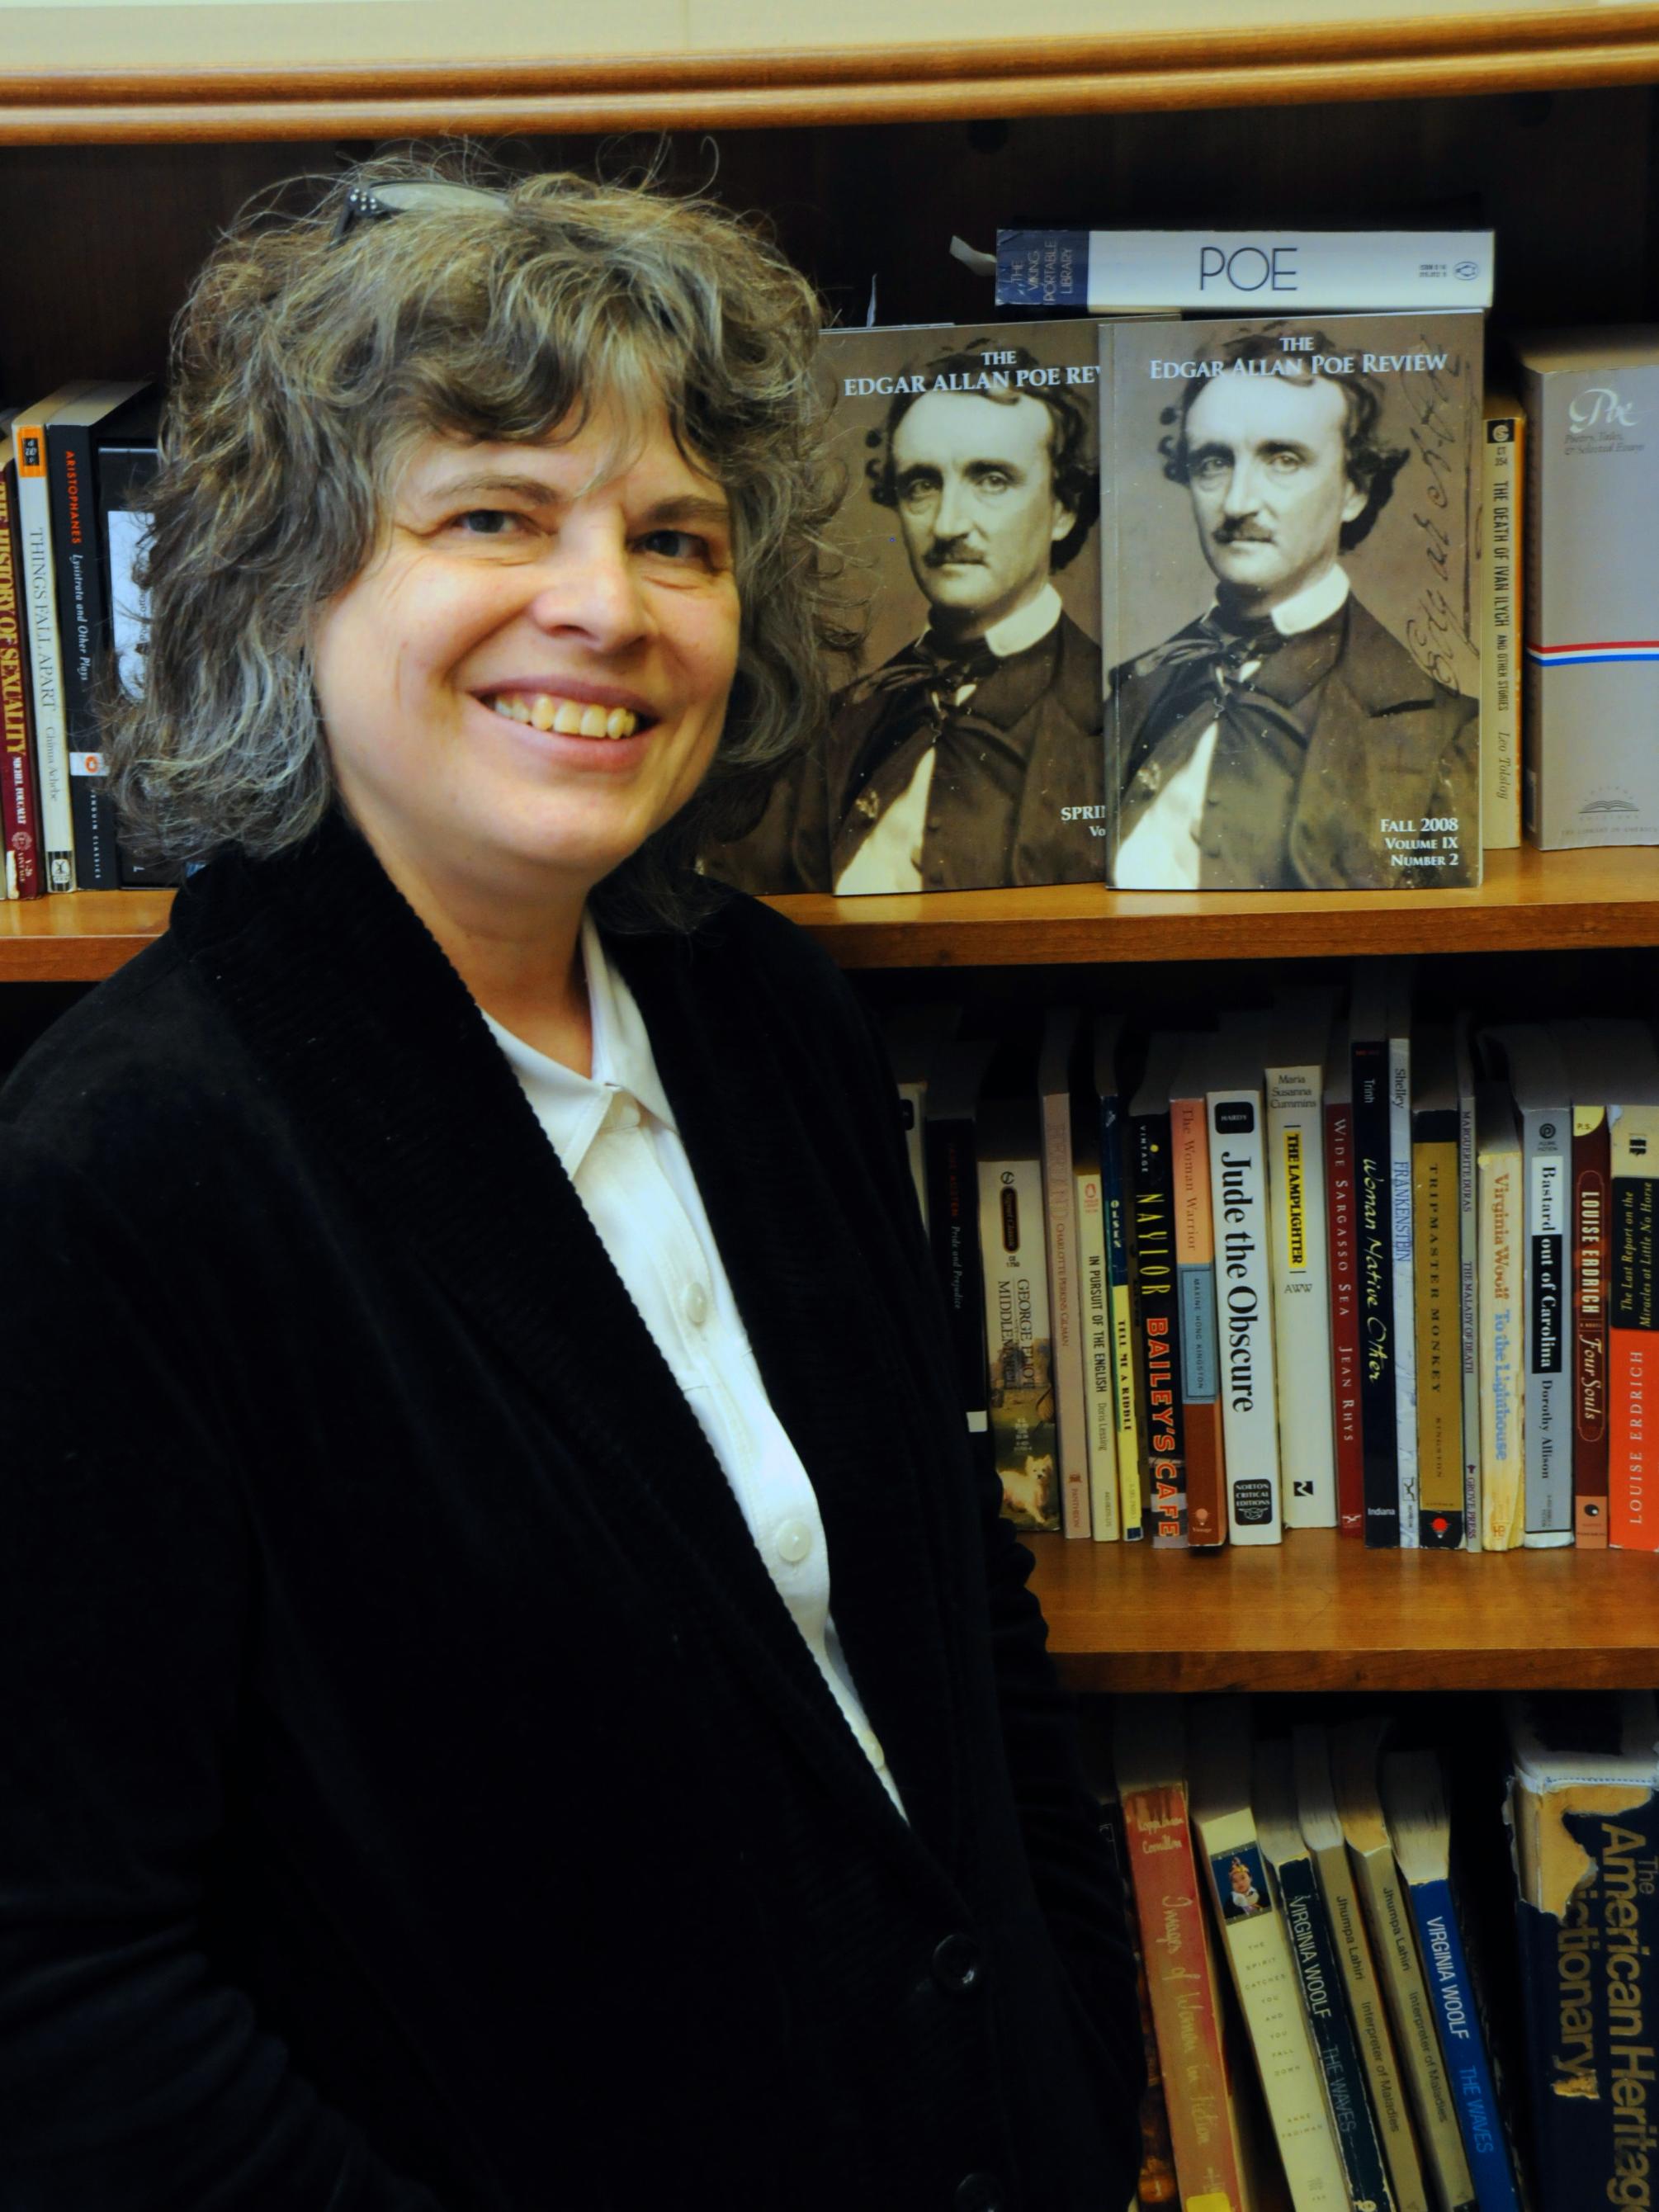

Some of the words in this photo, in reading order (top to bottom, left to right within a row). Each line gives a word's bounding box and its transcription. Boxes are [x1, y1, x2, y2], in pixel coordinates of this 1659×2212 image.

[1011, 259, 1023, 283] THE
[1028, 249, 1040, 291] VIKING
[1043, 239, 1057, 304] PORTABLE
[1061, 248, 1073, 294] LIBRARY
[1199, 247, 1298, 291] POE
[981, 350, 1017, 366] THE
[1280, 337, 1314, 352] THE
[844, 376, 926, 397] EDGAR
[932, 370, 1009, 392] ALLAN
[1015, 367, 1061, 388] POE
[1150, 360, 1226, 380] EDGAR
[1224, 357, 1303, 376] ALLAN
[1311, 354, 1356, 375] POE
[1363, 353, 1449, 373] REVIEW
[66, 451, 81, 544] ARISTOPHANES
[1493, 481, 1510, 502] THE
[1493, 507, 1510, 542] DEATH
[30, 527, 48, 600] THINGS
[1493, 547, 1509, 560] OF
[69, 554, 84, 601] Lysistrata
[1493, 565, 1510, 591] IVAN
[0, 617, 18, 645] OF
[35, 604, 51, 649] FALL
[77, 604, 87, 622] and
[1494, 596, 1510, 626] ILYCH
[78, 625, 88, 653] Other
[1497, 635, 1509, 650] AND
[39, 653, 56, 711] APART
[78, 657, 90, 681] Plays
[1497, 654, 1509, 678] OTHER
[0, 648, 26, 756] SEXUALITY
[1497, 681, 1510, 711] STORIES
[45, 726, 58, 764] Chinua
[1498, 731, 1510, 752] Leo
[12, 757, 24, 786] MICHEL
[48, 766, 59, 801] Achebe
[1496, 757, 1511, 800] Tolstoy
[1380, 819, 1416, 832] FALL
[1420, 817, 1459, 832] 2008
[1384, 837, 1439, 849] VOLUME
[1441, 836, 1459, 848] IX
[1390, 853, 1446, 867] NUMBER
[1449, 853, 1459, 866] 2
[1272, 1087, 1312, 1097] Susanna
[1279, 1075, 1306, 1084] Maria
[1364, 1078, 1376, 1104] Trinh
[1392, 1068, 1407, 1108] Shelley
[1182, 1108, 1195, 1134] The
[1271, 1099, 1316, 1108] Cummins
[1287, 1133, 1300, 1162] THE
[1334, 1118, 1347, 1166] WIDE
[1462, 1111, 1472, 1177] MARGUERITE
[1183, 1140, 1195, 1191] Woman
[1222, 1151, 1254, 1223] Jude
[1363, 1158, 1385, 1229] Woman
[1463, 1180, 1472, 1212] DURAS
[1541, 1166, 1557, 1231] Bastard
[1622, 1192, 1633, 1207] the
[1185, 1197, 1198, 1251] Warrior
[1288, 1165, 1303, 1264] LAMPLIGHTER
[1335, 1180, 1349, 1272] SARGASSO
[1394, 1161, 1411, 1262] FRANKENSTEIN
[1491, 1173, 1510, 1245] Virginia
[1581, 1192, 1600, 1242] LOUISE
[1625, 1212, 1634, 1224] on
[951, 1226, 961, 1248] Pride
[1056, 1222, 1067, 1275] CHARLOTTE
[1136, 1193, 1172, 1295] NAYLOR
[1429, 1164, 1440, 1299] TRIPMASTER
[1621, 1228, 1636, 1262] Report
[952, 1250, 962, 1267] and
[1089, 1255, 1100, 1266] IN
[1225, 1231, 1255, 1279] the
[1364, 1236, 1384, 1308] Native
[1494, 1245, 1510, 1299] Woolf
[1541, 1238, 1555, 1266] out
[952, 1270, 963, 1309] Prejudice
[1089, 1269, 1103, 1311] PURSUIT
[1463, 1262, 1473, 1283] THE
[1541, 1272, 1556, 1290] of
[1581, 1250, 1600, 1313] ERDRICH
[1620, 1267, 1634, 1288] Last
[1016, 1278, 1033, 1342] GEORGE
[1058, 1278, 1068, 1311] PERKINS
[1338, 1283, 1352, 1316] SEA
[1464, 1285, 1473, 1326] MALADY
[1620, 1292, 1633, 1311] The
[997, 1280, 1016, 1391] MIDDLEMARCH
[1060, 1312, 1070, 1347] GILMAN
[1092, 1314, 1103, 1326] OF
[1464, 1327, 1473, 1340] OF
[1495, 1309, 1511, 1332] To
[1540, 1296, 1557, 1368] Carolina
[1093, 1331, 1105, 1350] THE
[1227, 1286, 1259, 1413] Obscure
[1367, 1317, 1387, 1383] Other
[1431, 1309, 1441, 1393] MONKEY
[1464, 1342, 1474, 1373] DEATH
[1495, 1335, 1510, 1361] the
[1579, 1335, 1602, 1376] Four
[1022, 1346, 1035, 1389] ELIOT
[1094, 1354, 1108, 1393] ENGLISH
[1146, 1317, 1175, 1452] BAILEY'S
[1338, 1347, 1353, 1387] JEAN
[1097, 1402, 1108, 1422] Doris
[1492, 1364, 1510, 1461] Lighthouse
[1538, 1380, 1553, 1431] Dorothy
[1581, 1377, 1601, 1420] Souls
[1629, 1351, 1643, 1441] ERDRICH
[1098, 1424, 1109, 1453] Lessing
[1342, 1399, 1354, 1441] RHYS
[1435, 1417, 1444, 1478] KINGSTON
[1541, 1437, 1553, 1479] Allison
[1156, 1463, 1180, 1538] CAFE
[1629, 1452, 1643, 1524] LOUISE
[1638, 1855, 1659, 1895] The
[1155, 1896, 1194, 1955] Images
[1288, 1896, 1317, 1963] VIRGINIA
[1335, 1896, 1355, 1944] Jhumpa
[1383, 1887, 1401, 1936] Jhumpa
[1600, 1822, 1651, 2036] American
[1348, 1946, 1366, 1981] Lahiri
[1395, 1937, 1412, 1972] Lahiri
[1426, 1916, 1457, 1982] VIRGINIA
[1161, 1967, 1202, 1982] of
[1244, 1973, 1287, 1990] CATCHES
[1551, 1867, 1600, 2074] ictionary
[1303, 1964, 1331, 2019] WOOLF
[1360, 2002, 1383, 2062] Interpreter
[1408, 1991, 1431, 2053] Interpreter
[1440, 1984, 1470, 2040] WOOLF
[1322, 2044, 1345, 2077] THE
[1375, 2065, 1387, 2077] of
[1424, 2054, 1436, 2068] of
[1458, 2065, 1482, 2096] THE
[1329, 2077, 1357, 2134] WAVES
[1379, 2079, 1401, 2134] Maladies
[1428, 2070, 1449, 2124] Maladies
[1466, 2099, 1495, 2154] WAVES
[1606, 2044, 1657, 2212] Heritag
